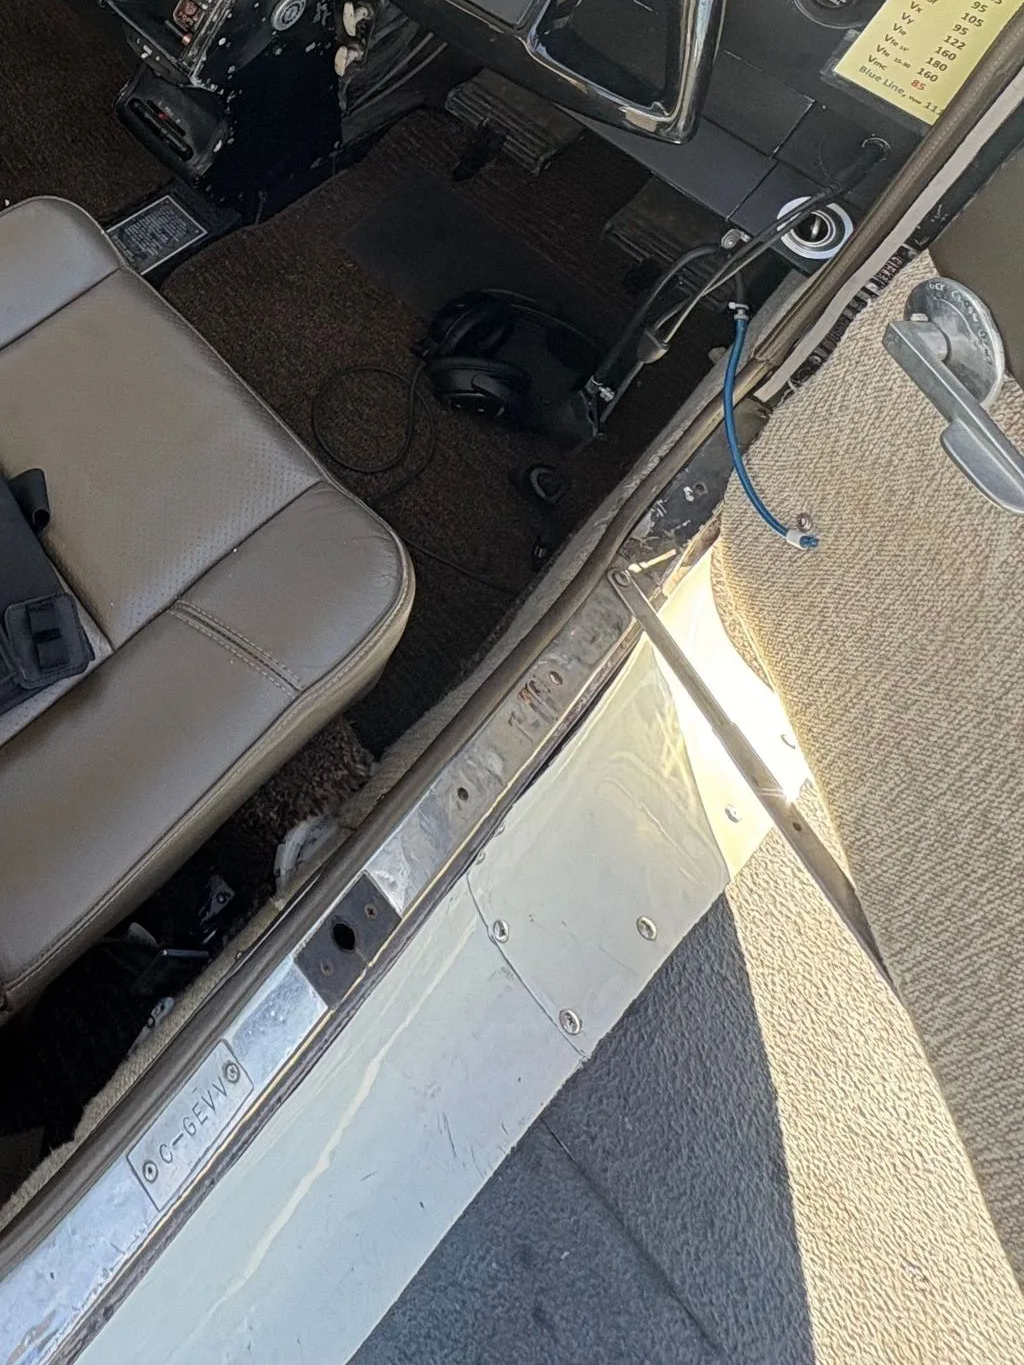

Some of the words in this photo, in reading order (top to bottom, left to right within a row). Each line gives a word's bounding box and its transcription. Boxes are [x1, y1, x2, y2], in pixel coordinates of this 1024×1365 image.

[910, 1, 923, 14] Vx
[952, 24, 970, 36] 95
[961, 12, 985, 28] 105
[971, 1, 988, 13] 95
[893, 23, 907, 36] Vle
[934, 46, 957, 62] 160
[901, 12, 915, 25] Vy
[943, 35, 966, 51] 122
[876, 44, 890, 58] Vfe
[917, 67, 939, 83] 160
[884, 34, 899, 47] Vfe
[925, 56, 948, 72] 180
[858, 65, 883, 83] Blue
[883, 78, 906, 98] Line,
[868, 54, 888, 71] Vmc
[910, 79, 926, 91] 85
[159, 1075, 228, 1164] C-GEVV
